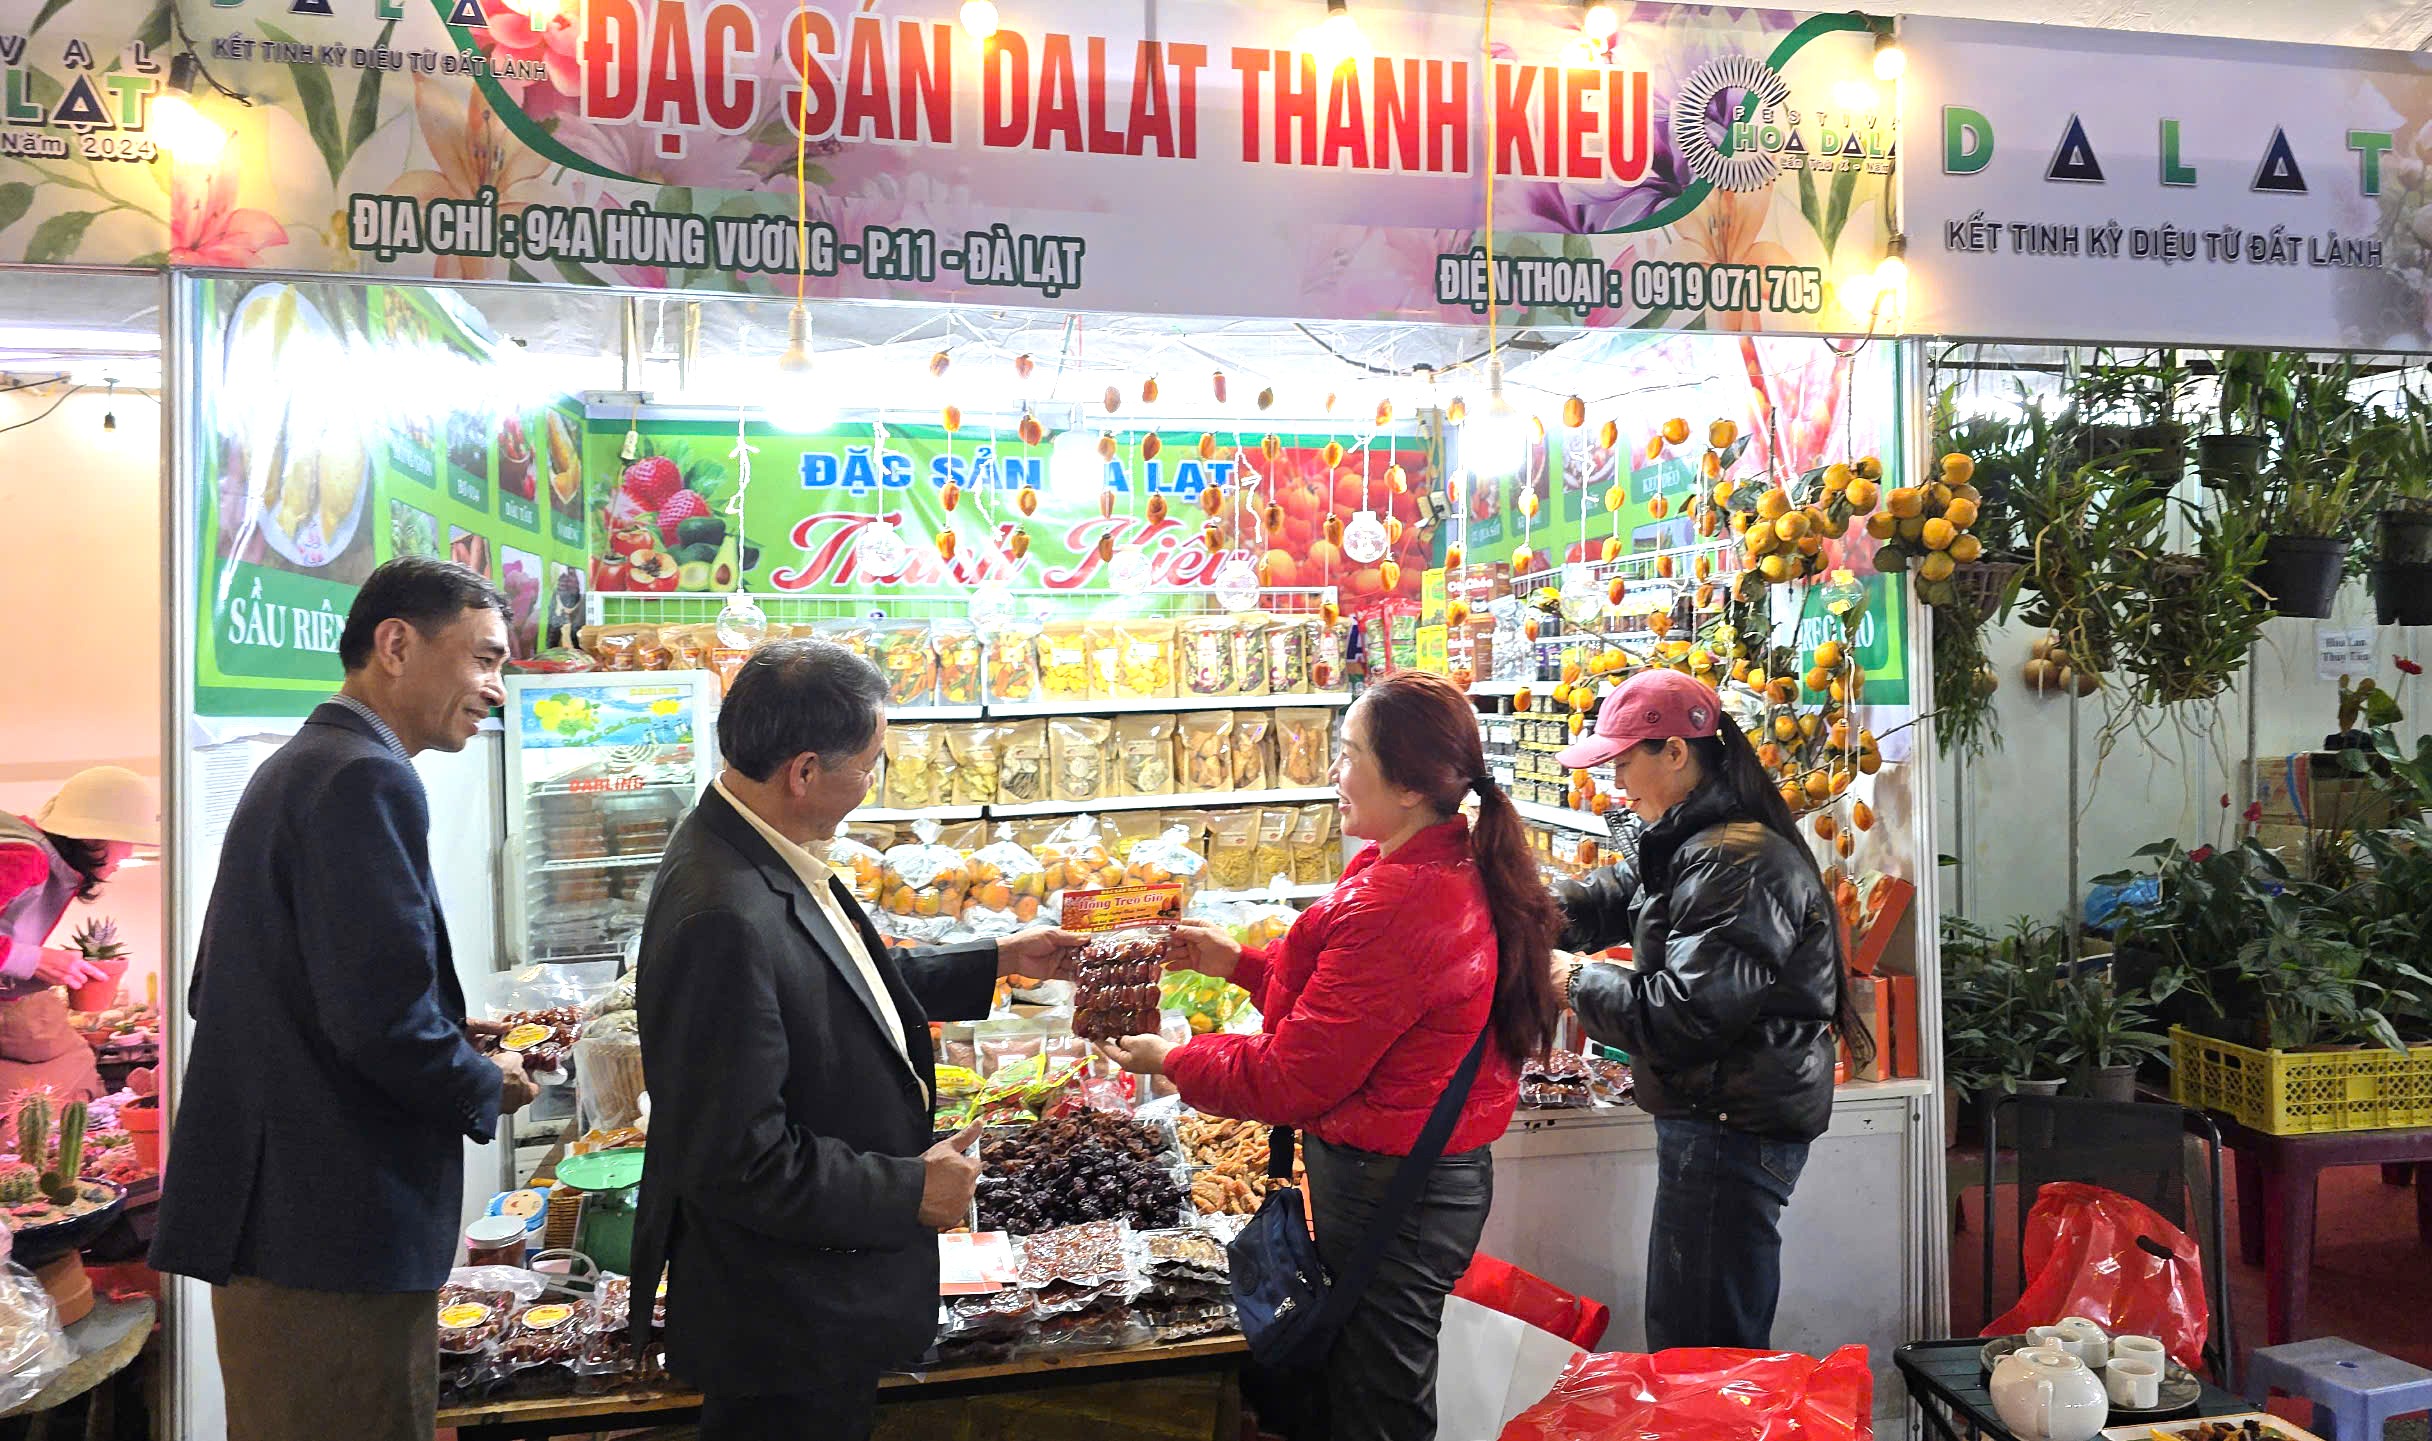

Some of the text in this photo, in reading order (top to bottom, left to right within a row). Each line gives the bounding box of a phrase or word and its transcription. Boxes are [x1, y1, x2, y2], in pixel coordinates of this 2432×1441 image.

[261, 41, 314, 65] TINH
[982, 28, 1208, 160] DALAT
[1231, 46, 1468, 173] THANH
[80, 135, 157, 162] 2024
[1733, 122, 1809, 155] HOA
[351, 196, 420, 260] ĐỊA
[428, 189, 494, 254] CHỈ
[525, 208, 597, 259] 94A
[605, 203, 706, 266] HÙNG
[714, 217, 834, 273] VƯƠNG
[866, 228, 932, 279] P.11
[967, 226, 1015, 282] ĐÀ
[1021, 237, 1082, 295] LẠT
[1945, 209, 2003, 252] KẾT
[2009, 222, 2080, 257] TINH
[2130, 222, 2197, 267] DIỆU
[2204, 228, 2243, 262] TỪ
[2246, 223, 2304, 265] ĐẤT
[2307, 230, 2385, 270] LÀNH
[1438, 249, 1511, 312] ĐIỆN
[1516, 259, 1602, 314] THOẠI
[1633, 263, 1701, 308] 0919
[1709, 266, 1760, 311] 071
[1766, 266, 1822, 312] 705
[801, 446, 915, 495] ĐẶC
